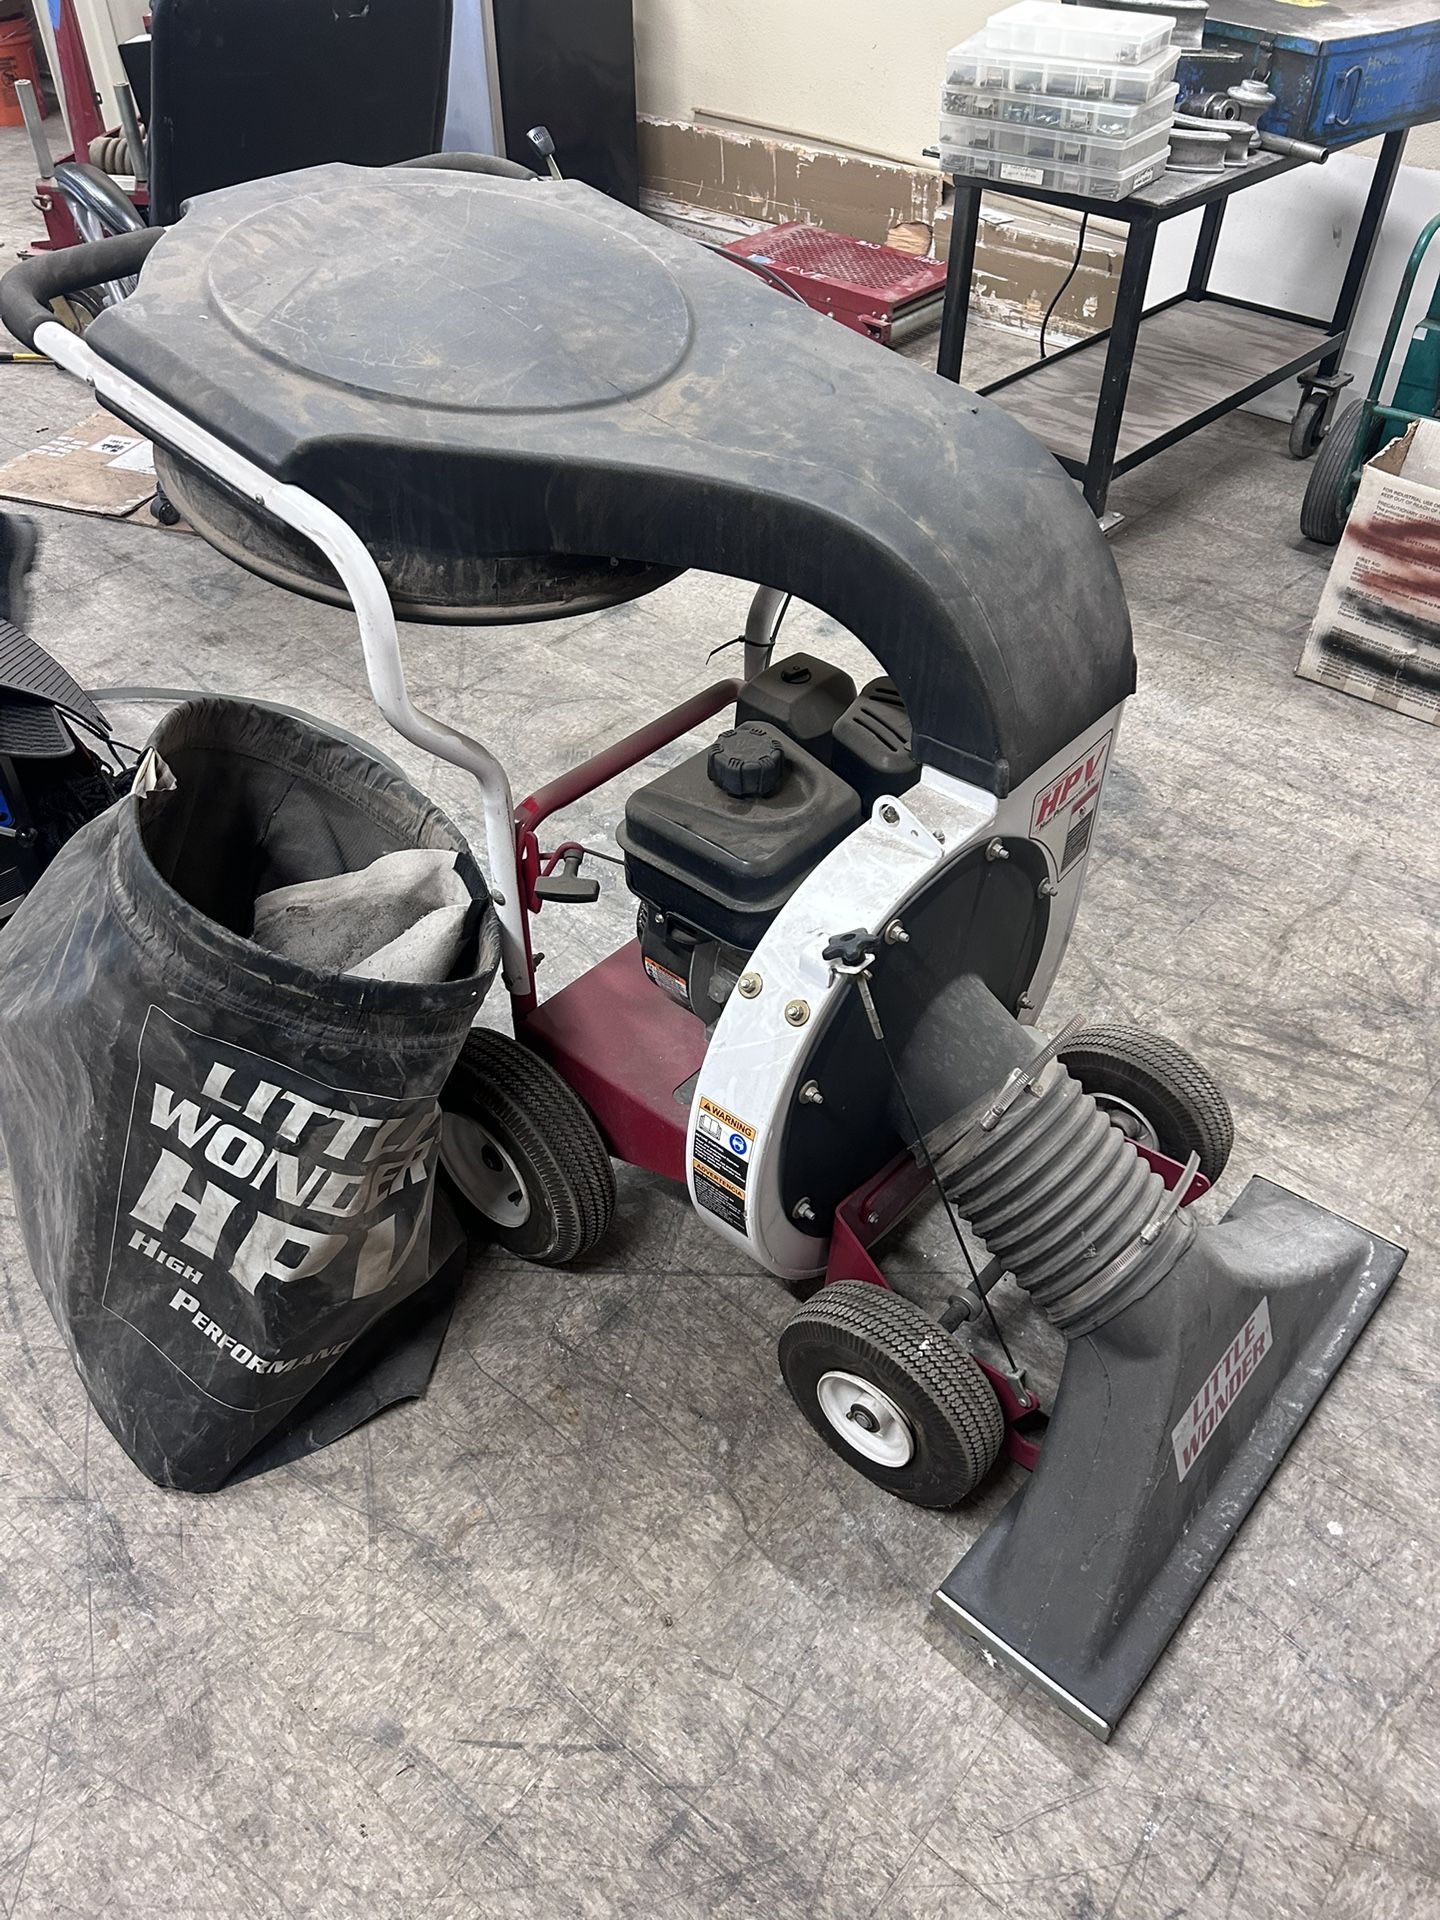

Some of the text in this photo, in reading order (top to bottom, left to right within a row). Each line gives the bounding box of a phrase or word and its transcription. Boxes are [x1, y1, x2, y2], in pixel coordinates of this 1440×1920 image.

[786, 265, 830, 281] CVE
[1377, 500, 1418, 517] PRECAUTIONARY
[1381, 492, 1394, 500] KEEP
[1413, 503, 1431, 512] REACH
[1393, 490, 1422, 503] INDUSTRIAL
[1406, 539, 1424, 548] SAFETY
[1357, 556, 1371, 564] FIRST
[1035, 744, 1106, 827] HPV
[712, 1106, 752, 1137] WARNING
[151, 1083, 434, 1218] WONDER
[696, 1164, 743, 1198] ADVERTENCIA
[129, 1148, 431, 1300] HPV
[128, 1229, 204, 1285] HIGH
[1192, 1316, 1256, 1427] LITTLE
[1182, 1331, 1266, 1470] WONDER
